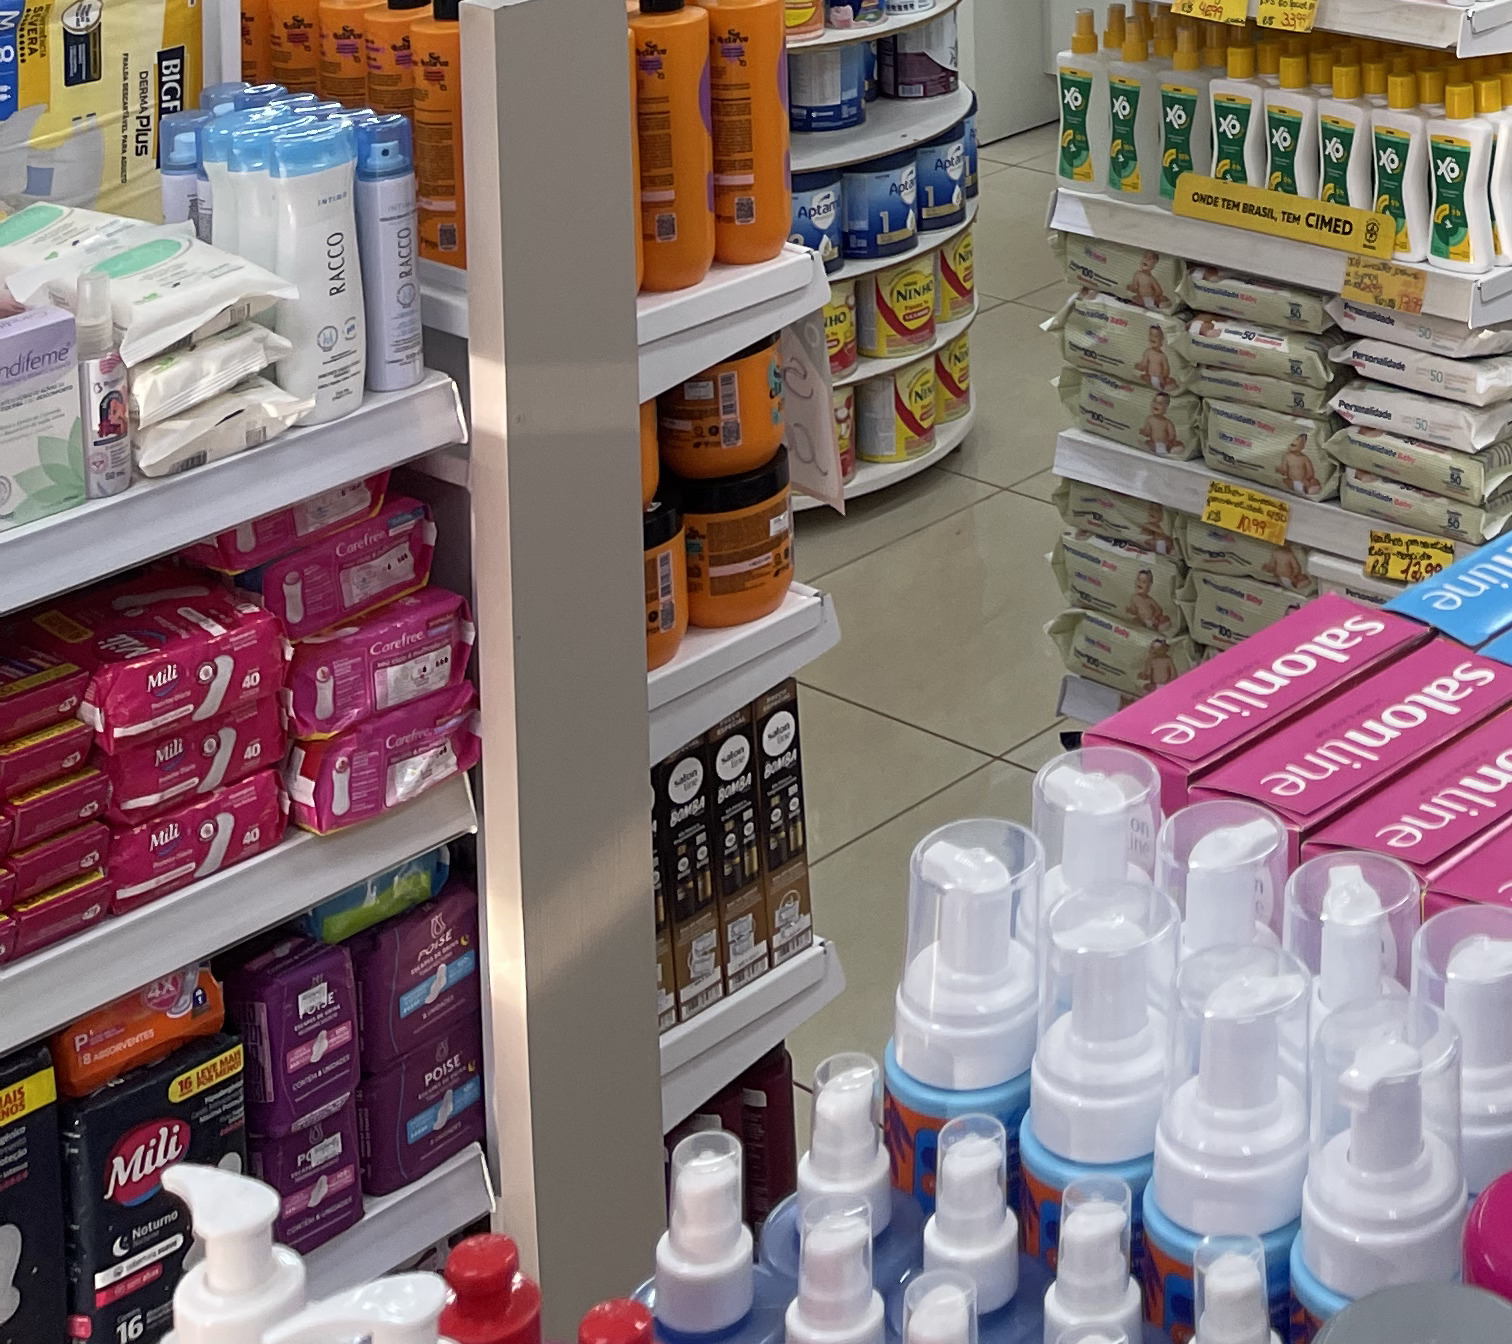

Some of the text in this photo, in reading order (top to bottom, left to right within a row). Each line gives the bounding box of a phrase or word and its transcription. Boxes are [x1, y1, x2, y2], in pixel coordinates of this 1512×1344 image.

[138, 70, 149, 114] DERMA
[162, 58, 182, 113] BIGF
[121, 82, 129, 134] DESCARTÁVEL
[889, 177, 917, 197] Apta
[798, 201, 838, 219] Aptam
[880, 211, 890, 234] 1
[1191, 191, 1353, 237] ONDE TEM BRASIL, TEM CIMED
[326, 231, 347, 297] RACCO
[397, 226, 413, 280] RACCO
[896, 280, 935, 303] NINHO
[1352, 349, 1406, 372] Personalidade
[1429, 368, 1444, 384] 50
[1338, 398, 1392, 421] Personalidade
[1414, 417, 1428, 433] 50
[335, 528, 386, 559] Carefree
[369, 629, 425, 657] Carefree
[146, 663, 179, 694] Mili
[242, 671, 261, 690] 40
[1151, 614, 1385, 745] salonline
[776, 729, 792, 746] line
[1259, 660, 1496, 796] salonline
[155, 737, 185, 768] Mili
[243, 742, 261, 761] 40
[731, 754, 746, 771] line
[763, 747, 798, 780] BOMBA
[683, 777, 699, 794] line
[717, 772, 752, 804] BOMBA
[670, 795, 706, 828] BOMBA
[149, 822, 180, 853] Mili
[417, 928, 454, 962] POISE
[197, 1048, 242, 1081] LEVE MAIS
[424, 1053, 462, 1088] POISE
[177, 1077, 193, 1094] 16
[198, 1071, 215, 1090] POR
[103, 1122, 185, 1202] Mili
[131, 1210, 179, 1239] Noturno
[115, 1314, 144, 1344] 16
